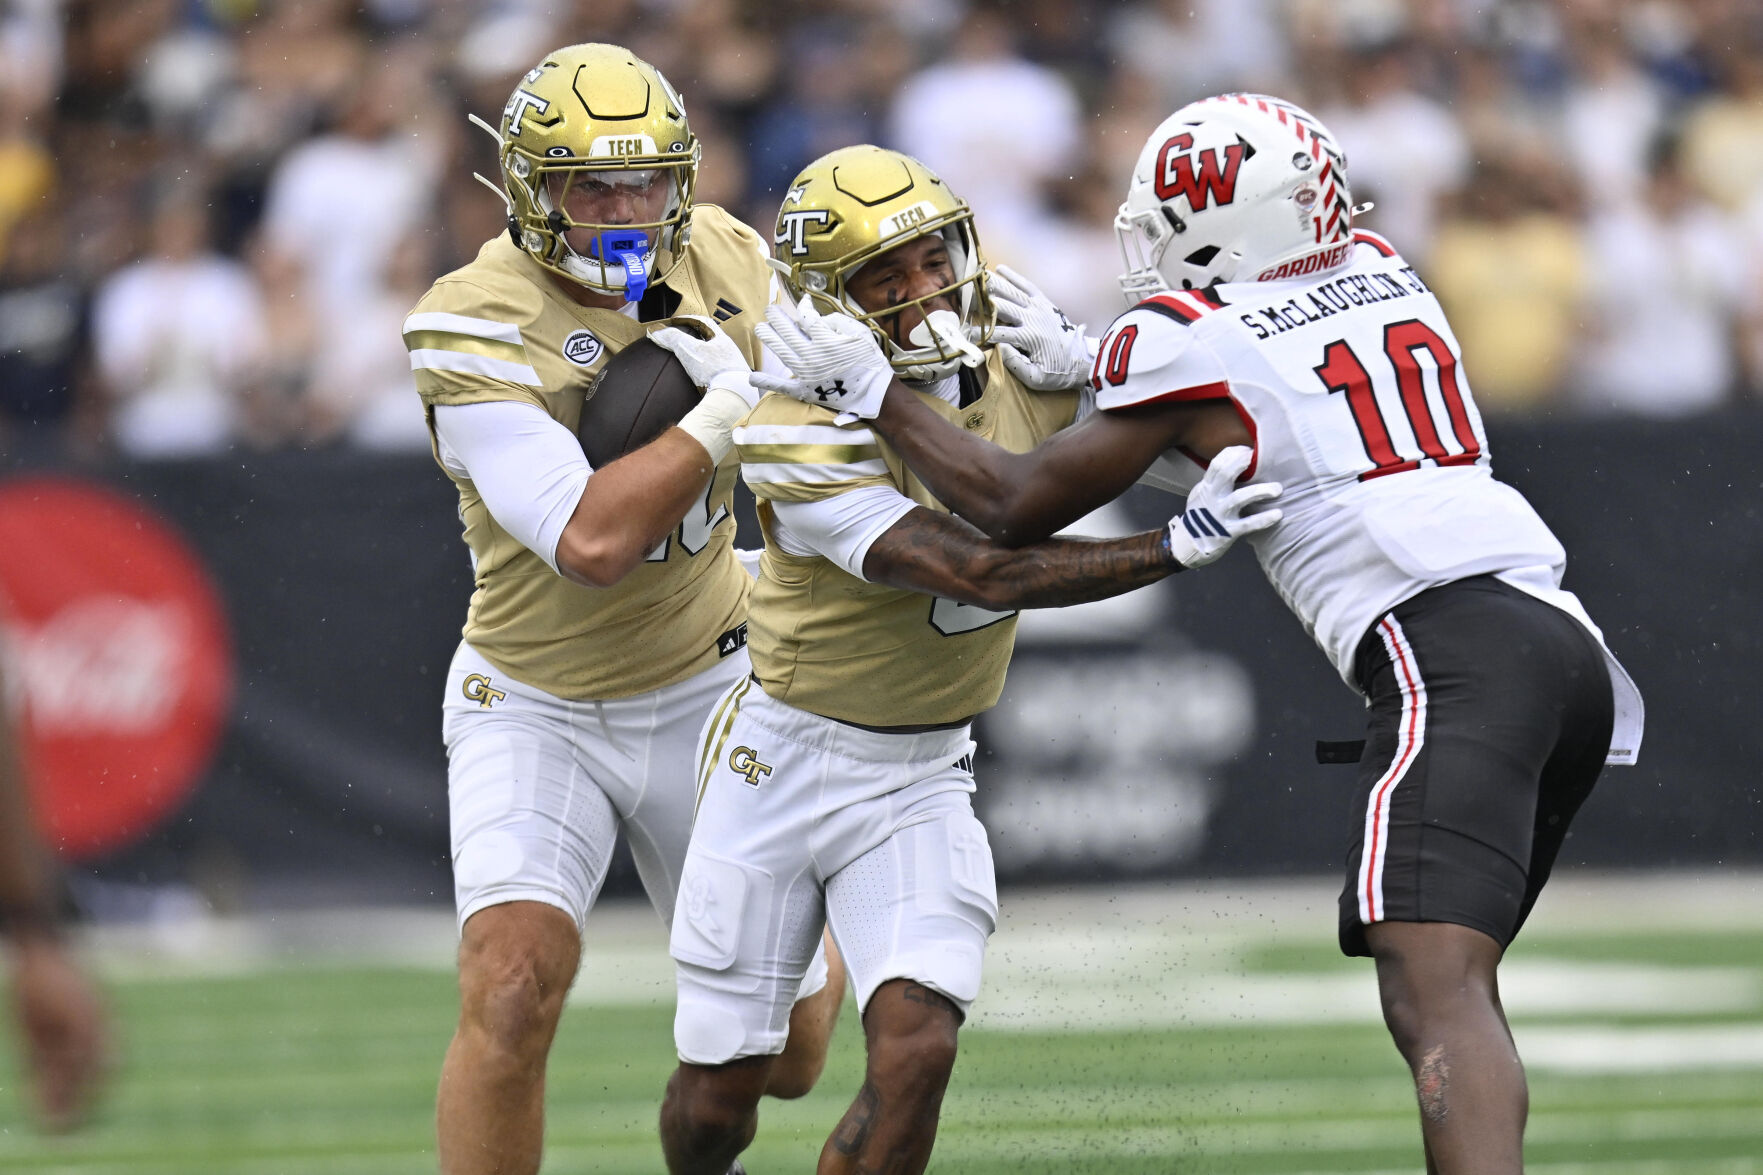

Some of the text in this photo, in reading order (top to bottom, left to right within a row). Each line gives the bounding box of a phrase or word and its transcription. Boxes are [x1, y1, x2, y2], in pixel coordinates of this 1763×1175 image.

[608, 138, 643, 157] TECH
[1154, 132, 1245, 213] GW
[891, 205, 927, 231] TECH
[1399, 265, 1432, 294] J
[570, 338, 595, 354] ACC
[1311, 318, 1482, 482] 10
[462, 672, 507, 709] GT
[729, 745, 773, 787] GT
